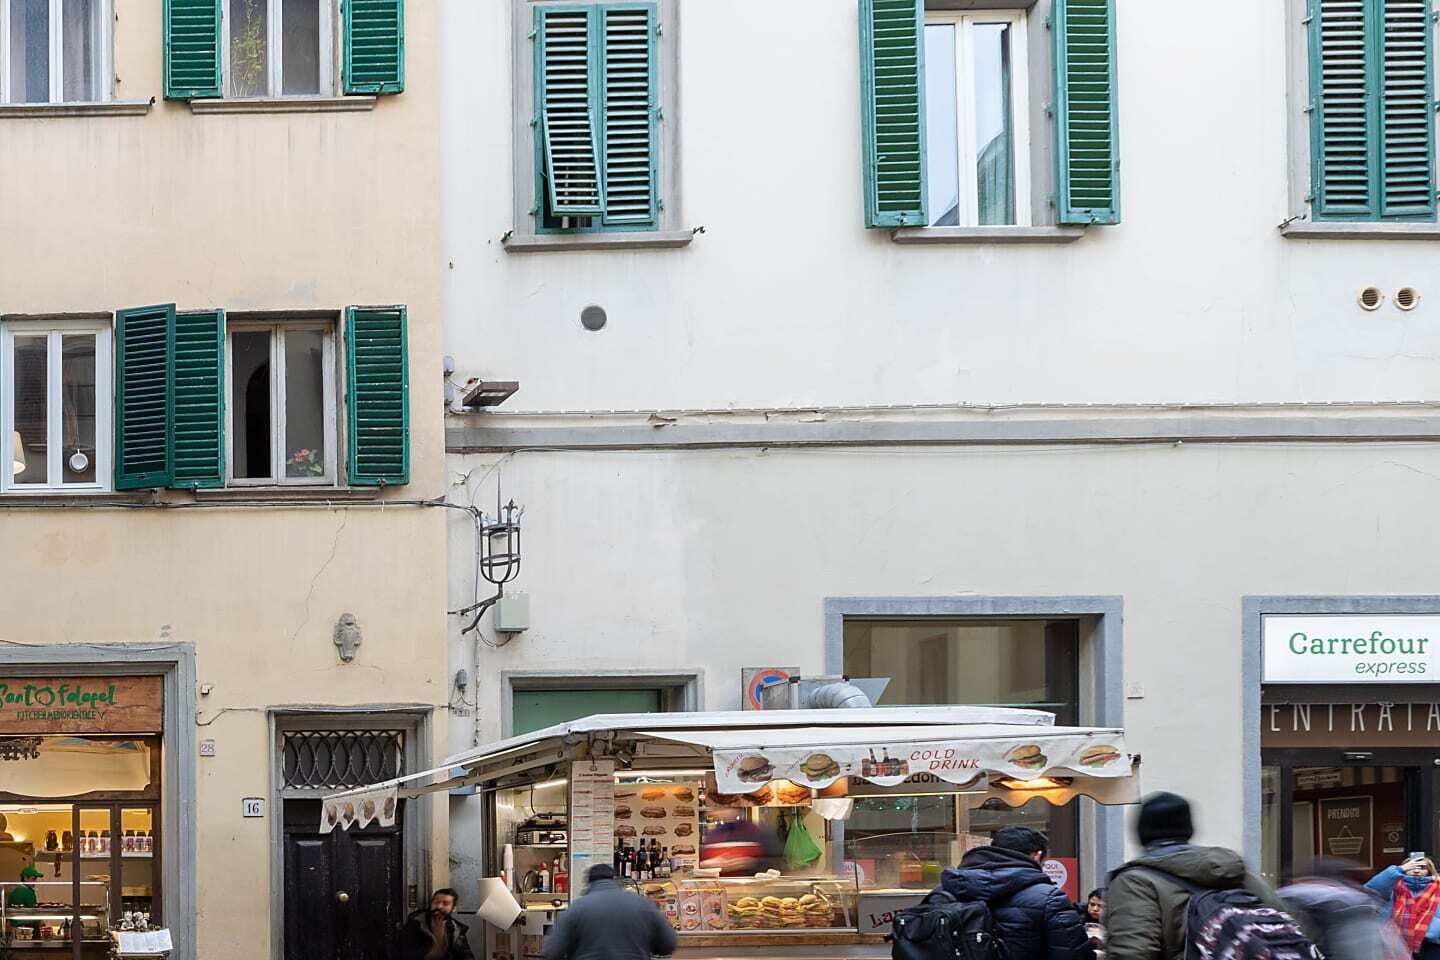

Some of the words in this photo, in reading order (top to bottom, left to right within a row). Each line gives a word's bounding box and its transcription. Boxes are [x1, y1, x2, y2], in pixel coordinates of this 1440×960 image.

[1289, 631, 1428, 655] Carrefour
[1355, 661, 1427, 677] express
[201, 743, 215, 753] 28
[910, 749, 955, 761] COLD
[929, 759, 980, 770] DRINK
[247, 802, 260, 814] 16
